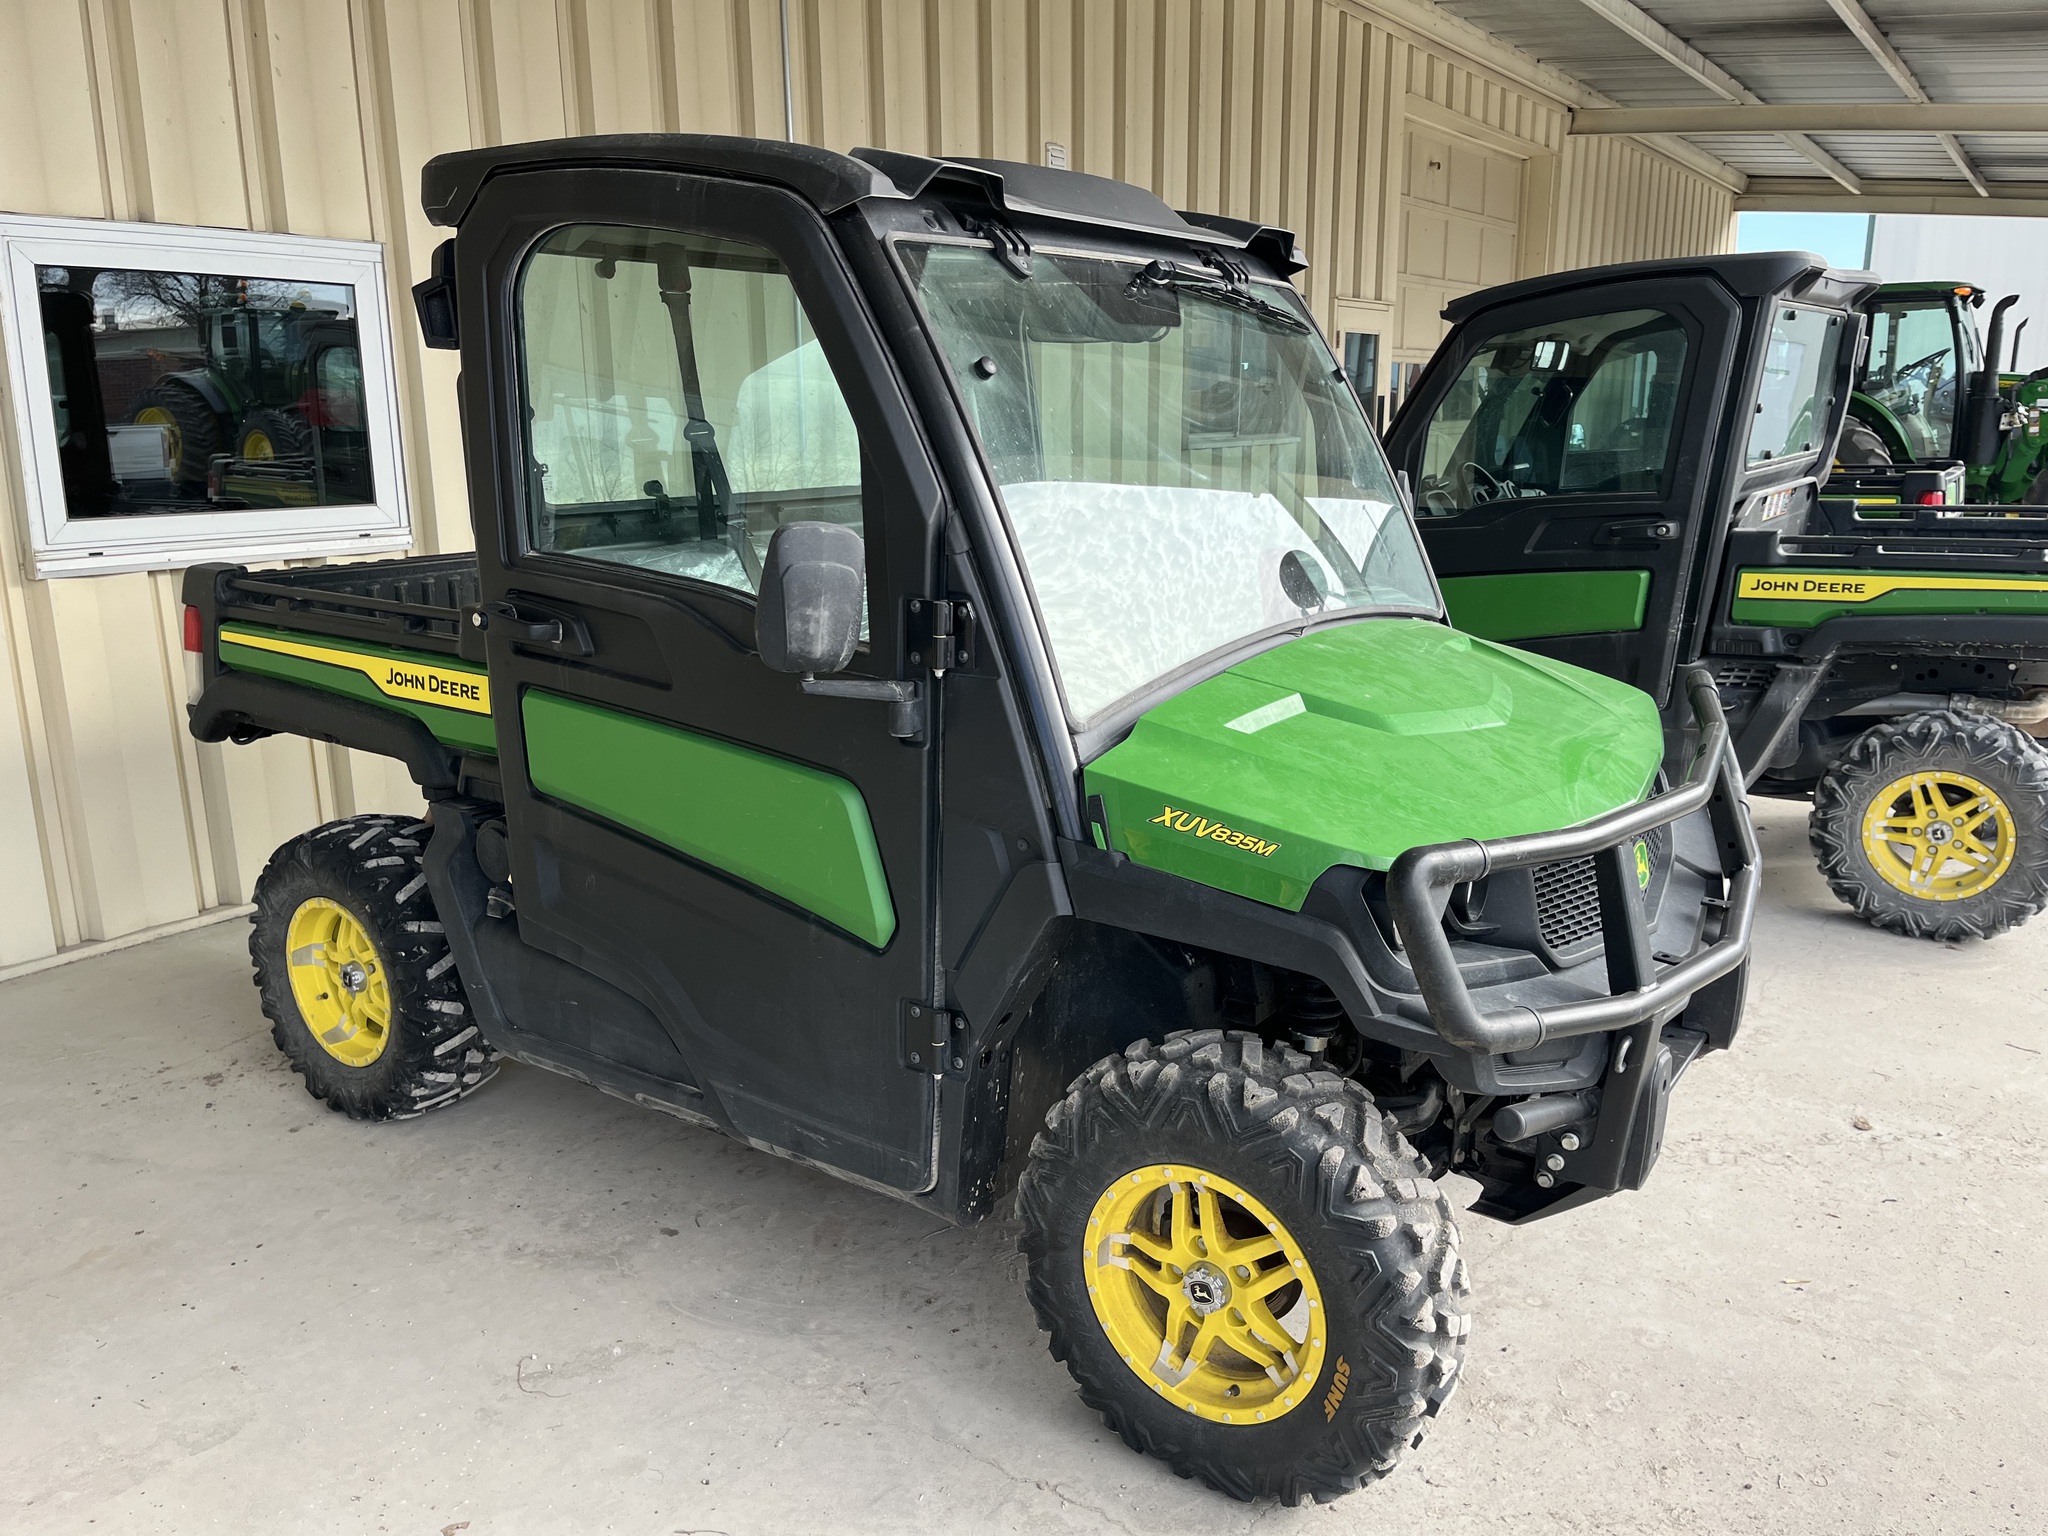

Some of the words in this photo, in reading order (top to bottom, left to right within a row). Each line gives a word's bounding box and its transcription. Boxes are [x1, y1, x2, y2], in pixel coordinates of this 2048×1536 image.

[1750, 579, 1798, 592] JOHN
[1803, 580, 1865, 593] DEERE
[386, 668, 425, 690] JOHN
[429, 675, 480, 700] DEERE
[1148, 804, 1281, 858] XUV835M
[1323, 1354, 1351, 1423] SUNF
